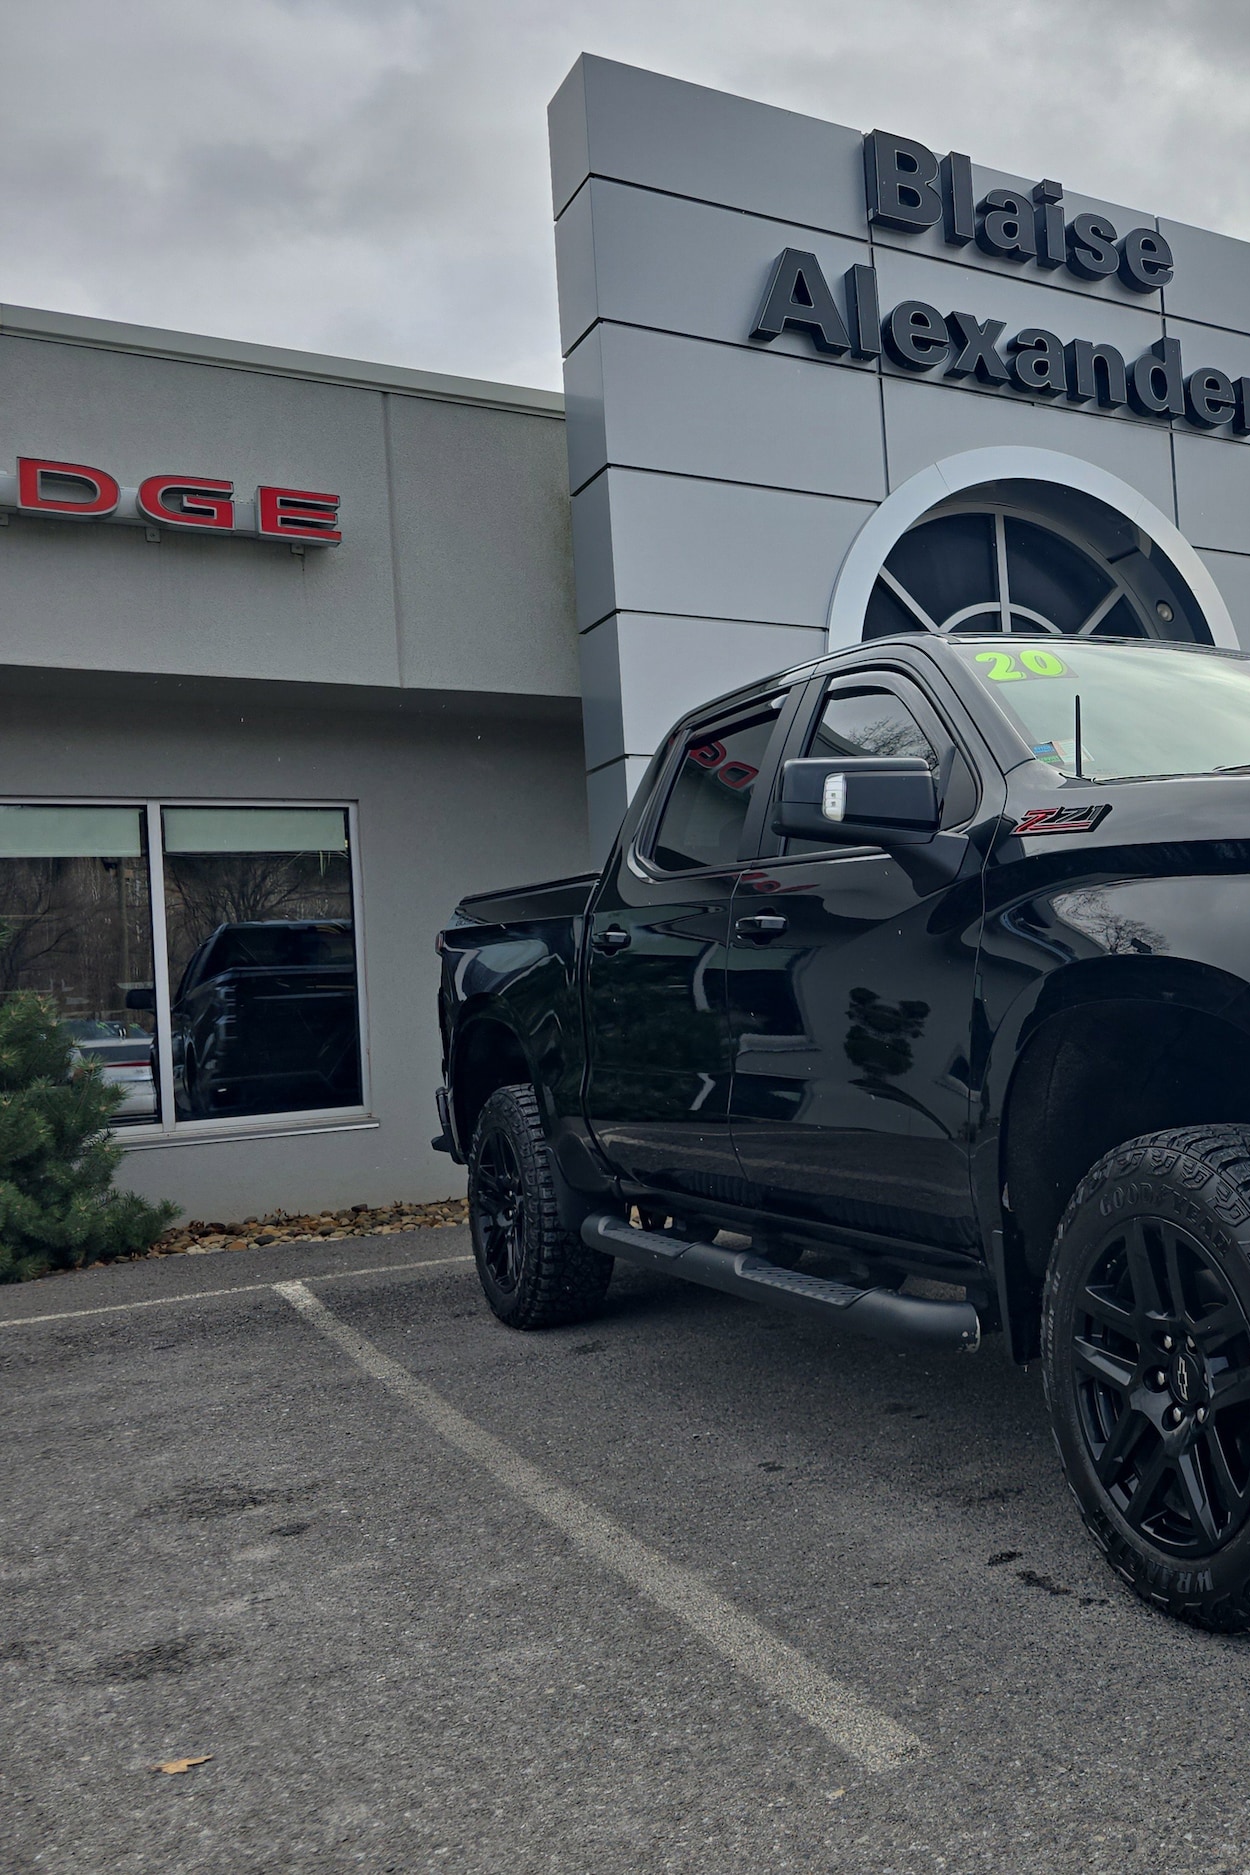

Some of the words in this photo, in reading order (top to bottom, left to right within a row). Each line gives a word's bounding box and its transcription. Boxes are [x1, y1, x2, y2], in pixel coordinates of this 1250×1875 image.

[864, 129, 1174, 293] Blaise
[17, 456, 342, 547] DGE
[975, 650, 1068, 681] 20
[1011, 803, 1113, 836] Z71
